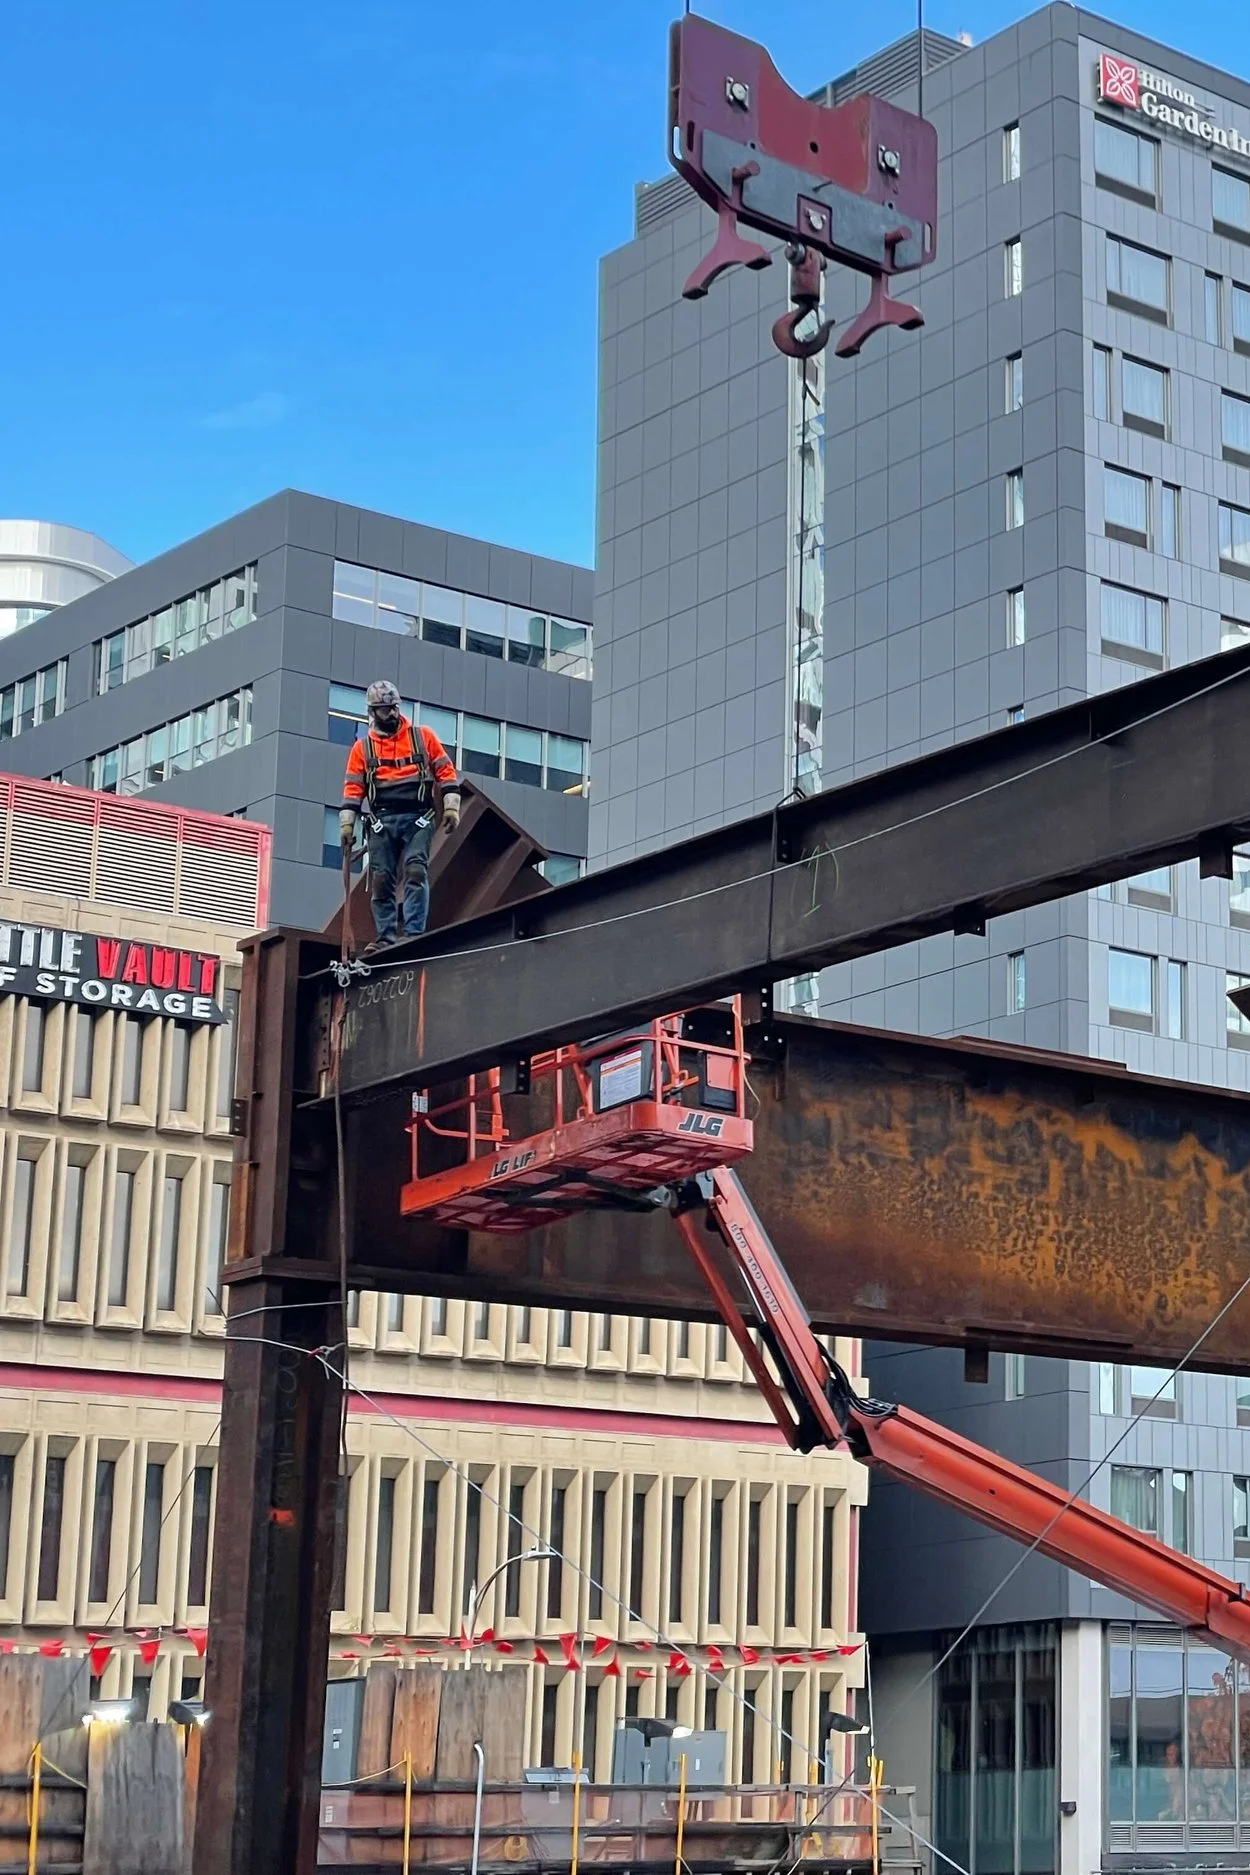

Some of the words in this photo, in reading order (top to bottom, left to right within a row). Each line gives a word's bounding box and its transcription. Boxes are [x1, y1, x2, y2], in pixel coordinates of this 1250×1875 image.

[1140, 70, 1195, 107] Hilton
[1141, 92, 1228, 149] Garden
[97, 937, 220, 996] VAULT
[36, 973, 212, 1018] STORAGE
[678, 1112, 724, 1137] JLG
